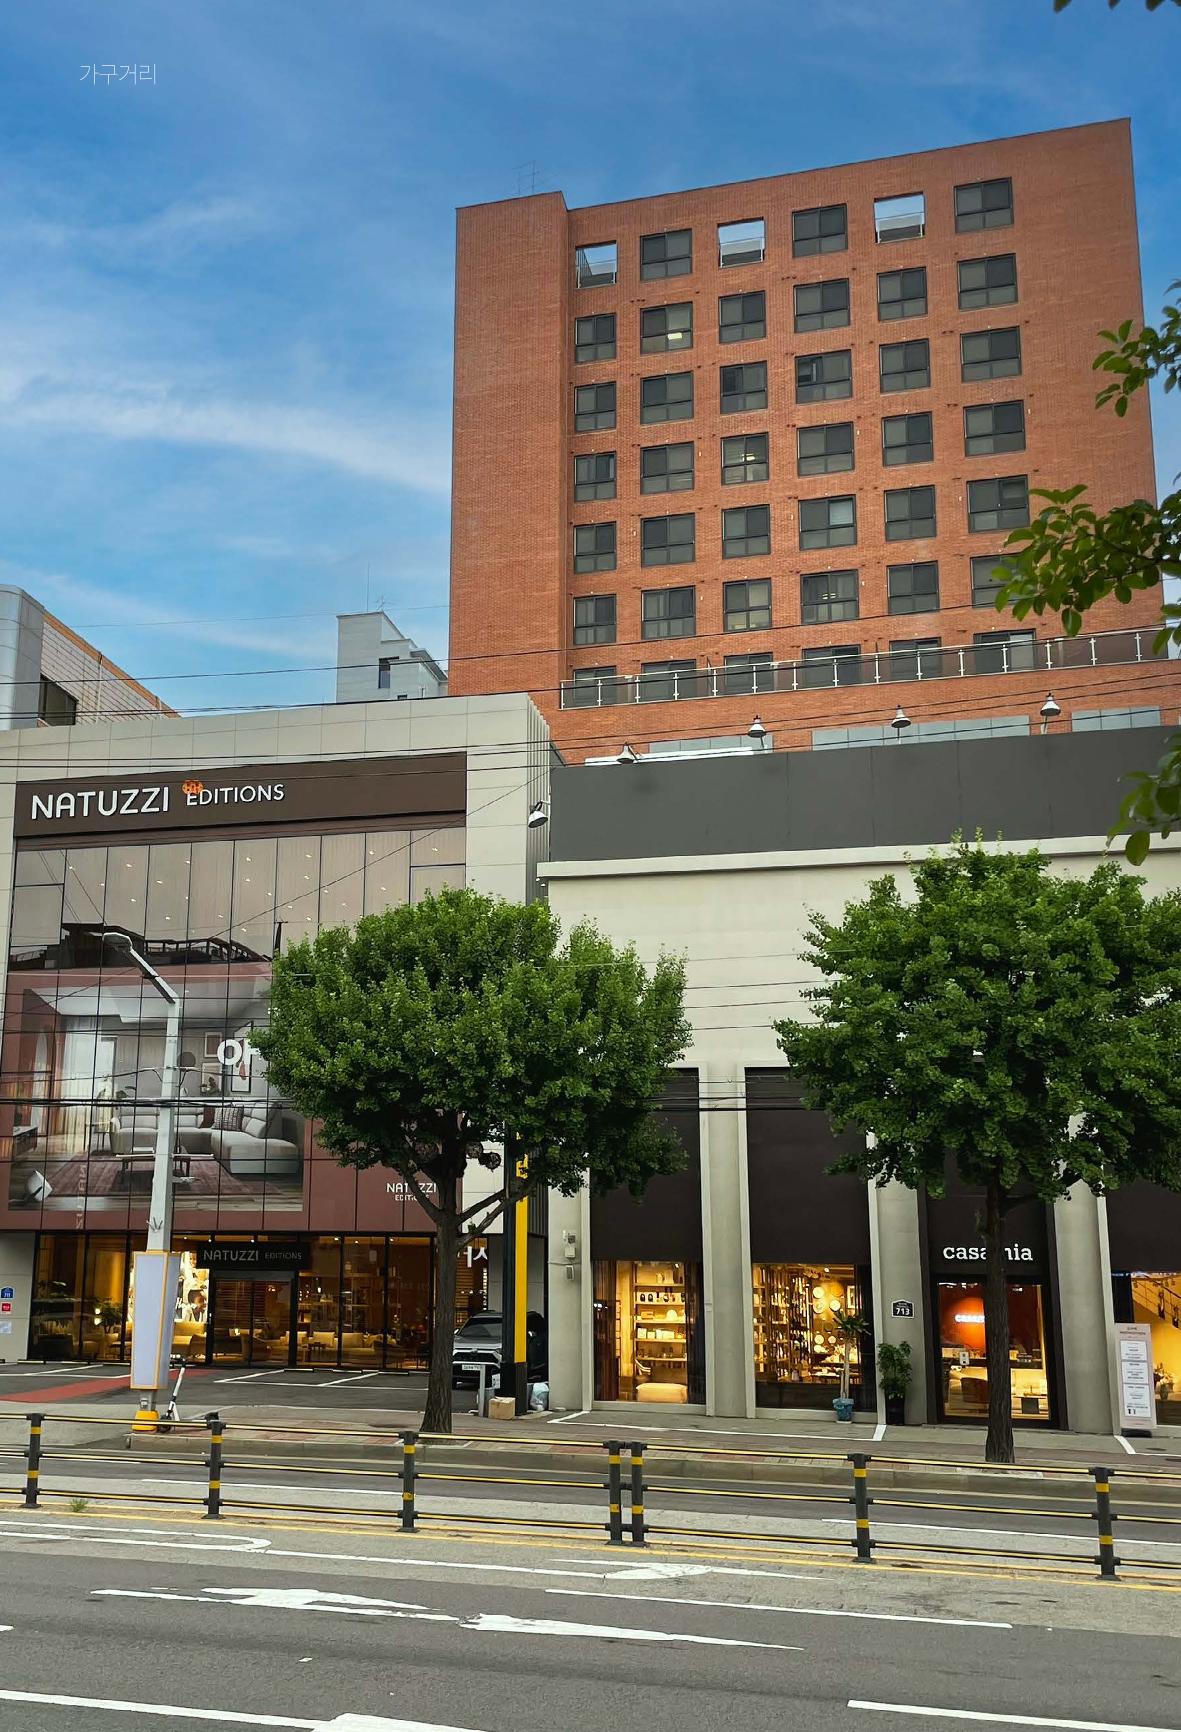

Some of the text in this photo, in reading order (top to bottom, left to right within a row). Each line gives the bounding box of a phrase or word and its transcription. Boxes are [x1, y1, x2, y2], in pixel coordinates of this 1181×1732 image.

[31, 783, 285, 820] NATUZZI EDITIONS
[386, 1182, 437, 1193] NATZZI
[203, 1250, 302, 1261] NATUZZI EDITIONS
[896, 1307, 910, 1316] 713
